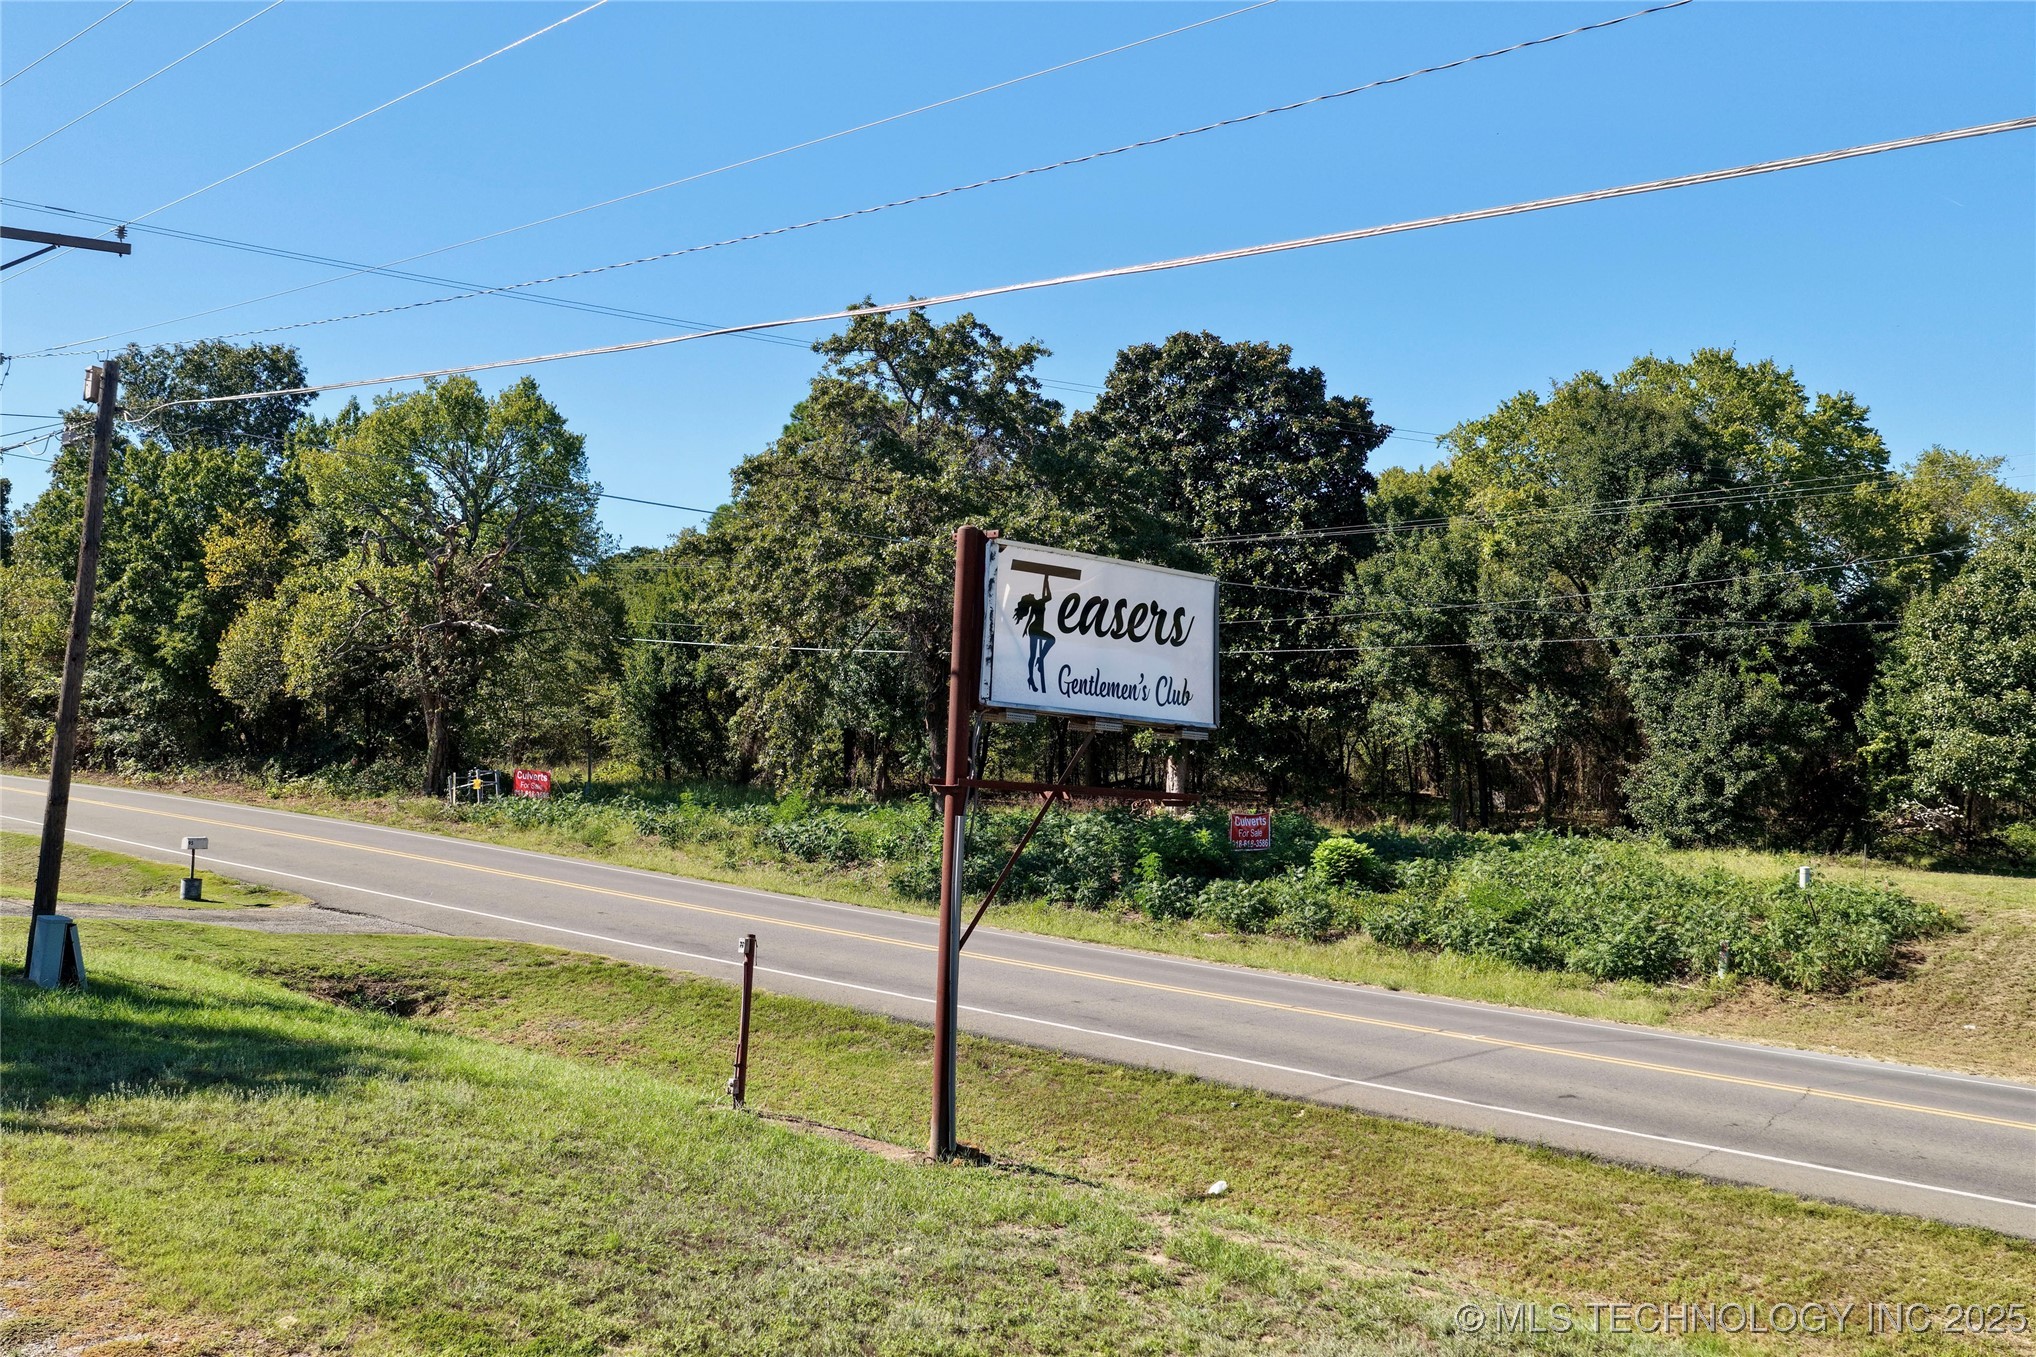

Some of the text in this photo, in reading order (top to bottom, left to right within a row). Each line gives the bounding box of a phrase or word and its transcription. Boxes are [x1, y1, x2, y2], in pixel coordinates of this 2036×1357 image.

[1058, 664, 1193, 707] Gentlemen's Club
[517, 771, 548, 782] Culverts
[1234, 816, 1266, 826] Culverts
[1238, 829, 1262, 838] For Sale
